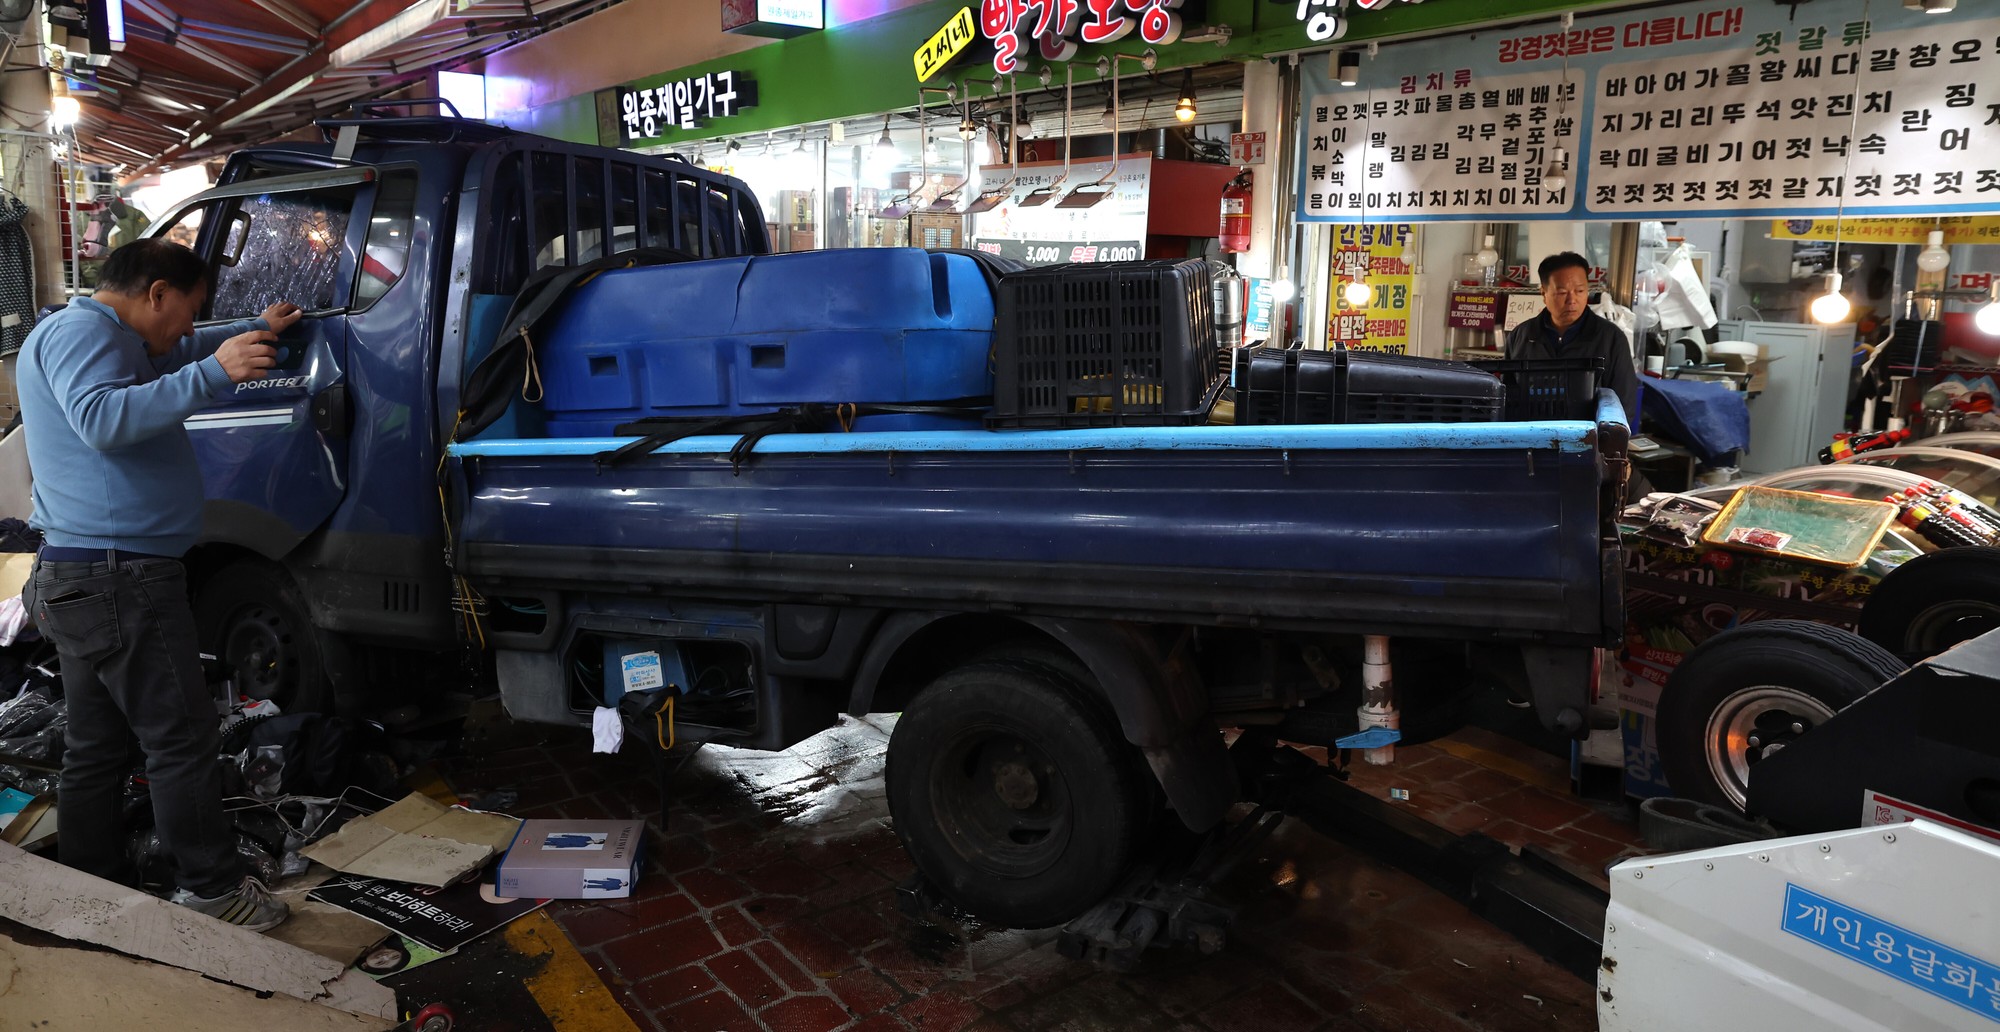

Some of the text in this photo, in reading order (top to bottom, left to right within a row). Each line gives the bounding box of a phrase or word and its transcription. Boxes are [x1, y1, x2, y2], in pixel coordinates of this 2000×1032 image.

[921, 14, 970, 77] 고씨네
[1498, 7, 1743, 63] 강경젓갈은 다릅니다!
[1400, 69, 1472, 94] 김치류
[623, 70, 737, 139] 원종제일가구
[1234, 133, 1264, 142] 소화기
[1026, 245, 1060, 263] 3,000
[1332, 314, 1367, 340] 1일전
[1462, 318, 1481, 326] 5,000
[235, 378, 296, 394] PORTER
